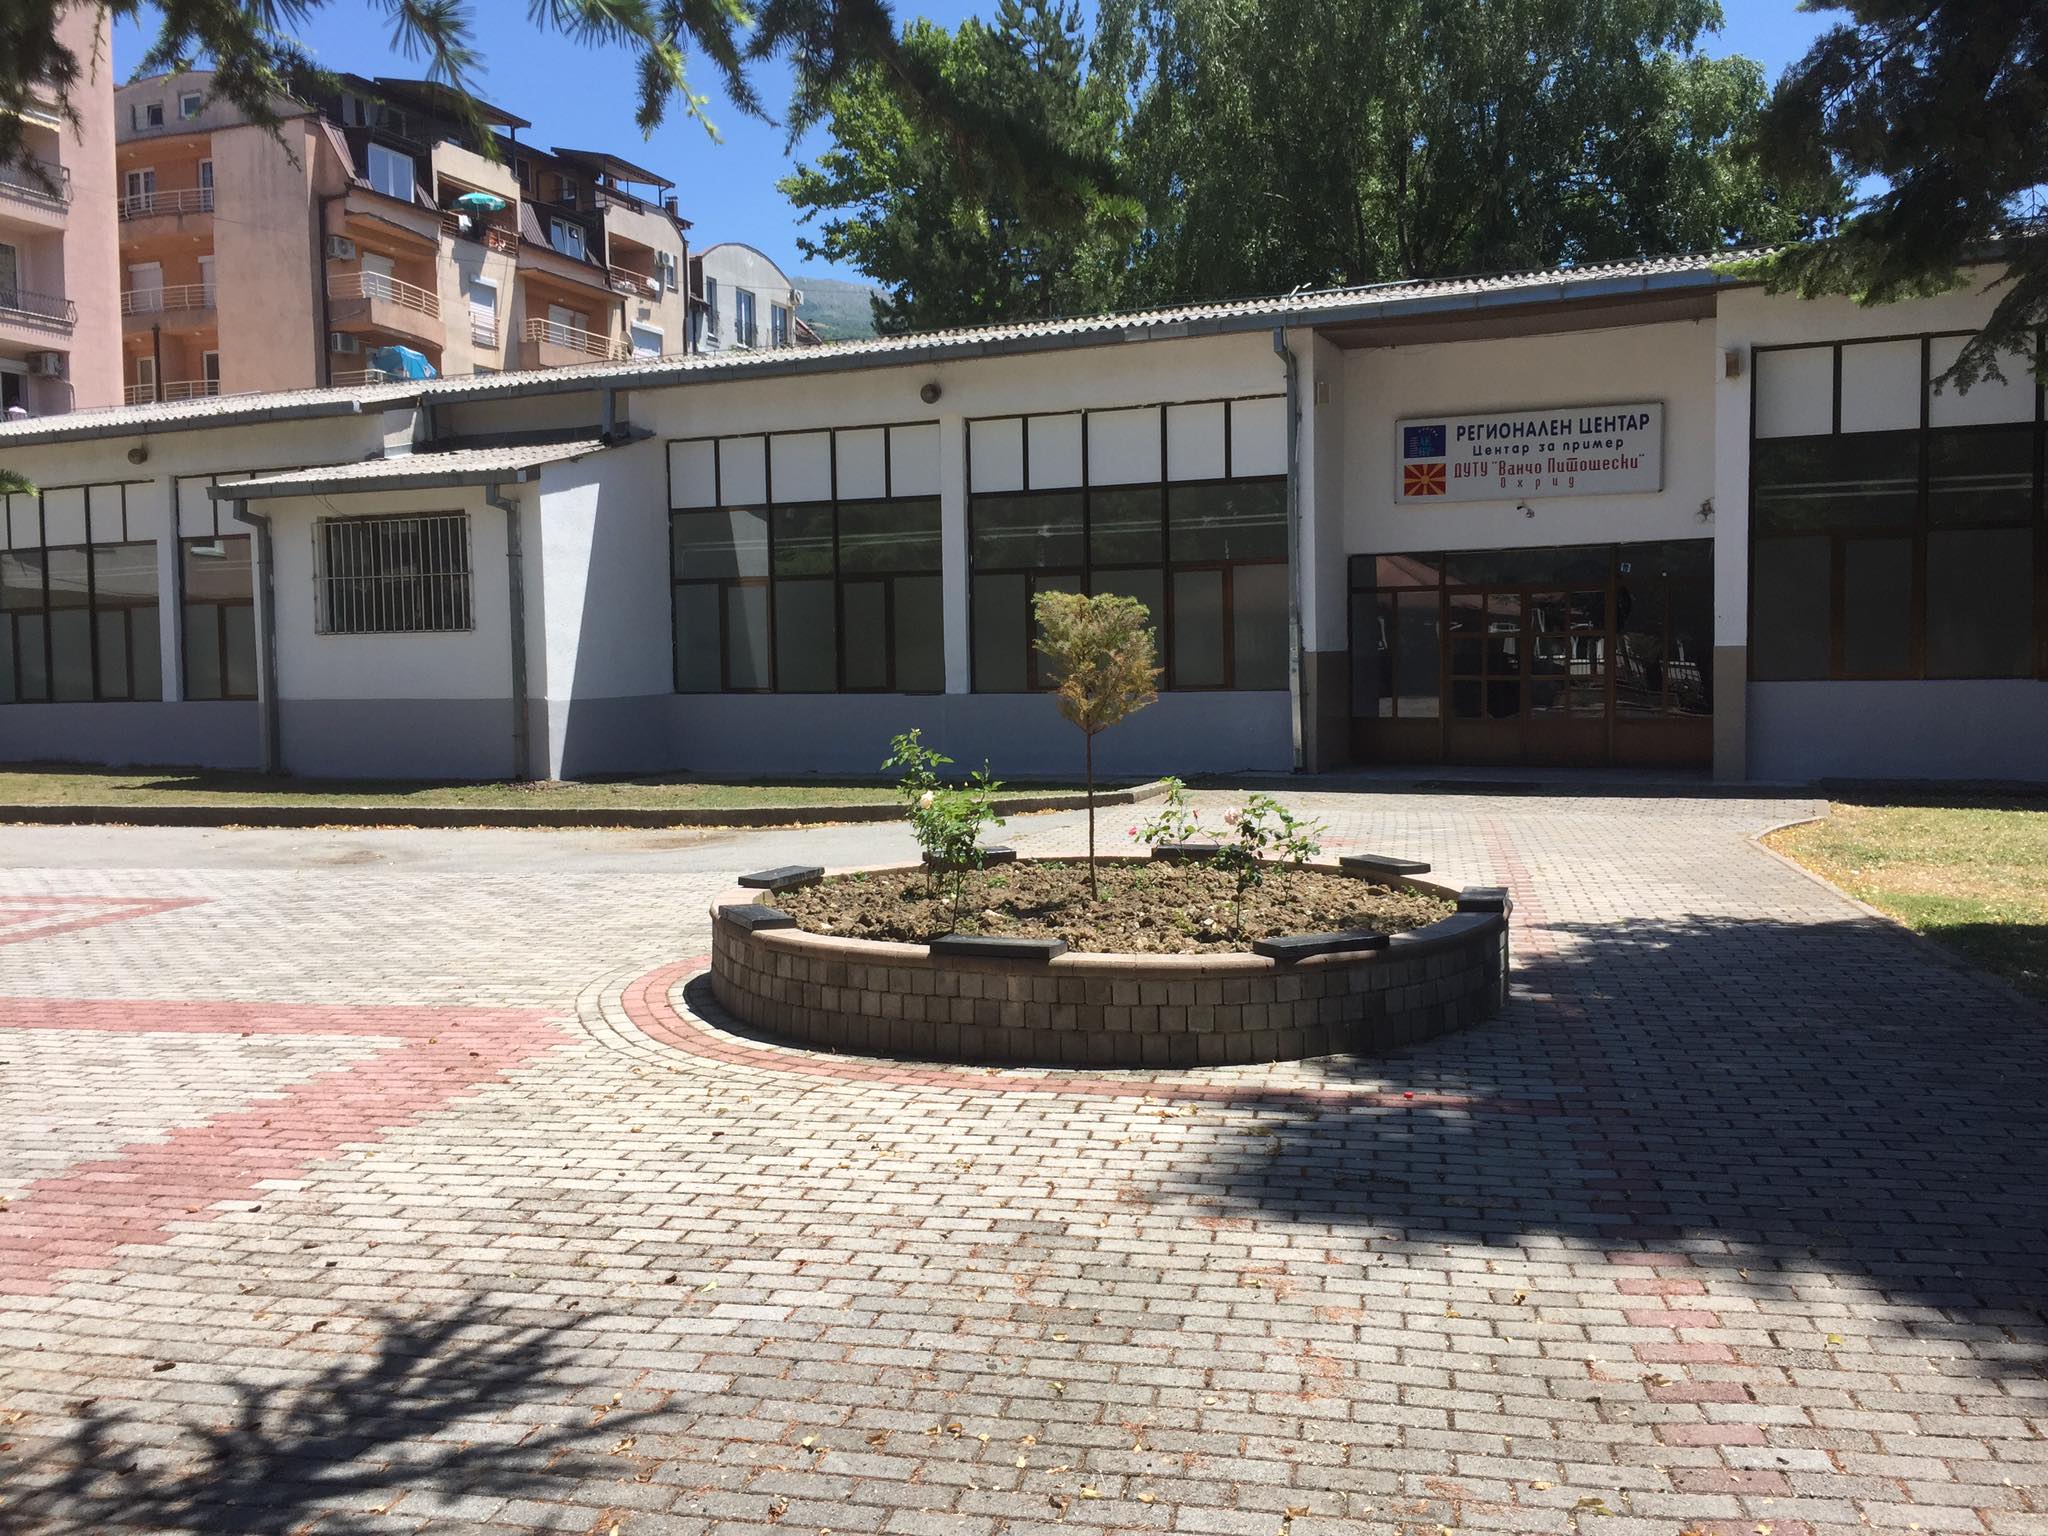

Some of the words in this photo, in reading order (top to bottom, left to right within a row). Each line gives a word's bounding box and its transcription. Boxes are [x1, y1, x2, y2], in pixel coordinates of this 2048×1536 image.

[1456, 419, 1572, 441] РЕГИОНАЛЕН
[1579, 413, 1650, 434] ЦЕНТАР
[1473, 443, 1530, 456] Центар
[1538, 442, 1555, 452] за
[1563, 438, 1624, 452] пример
